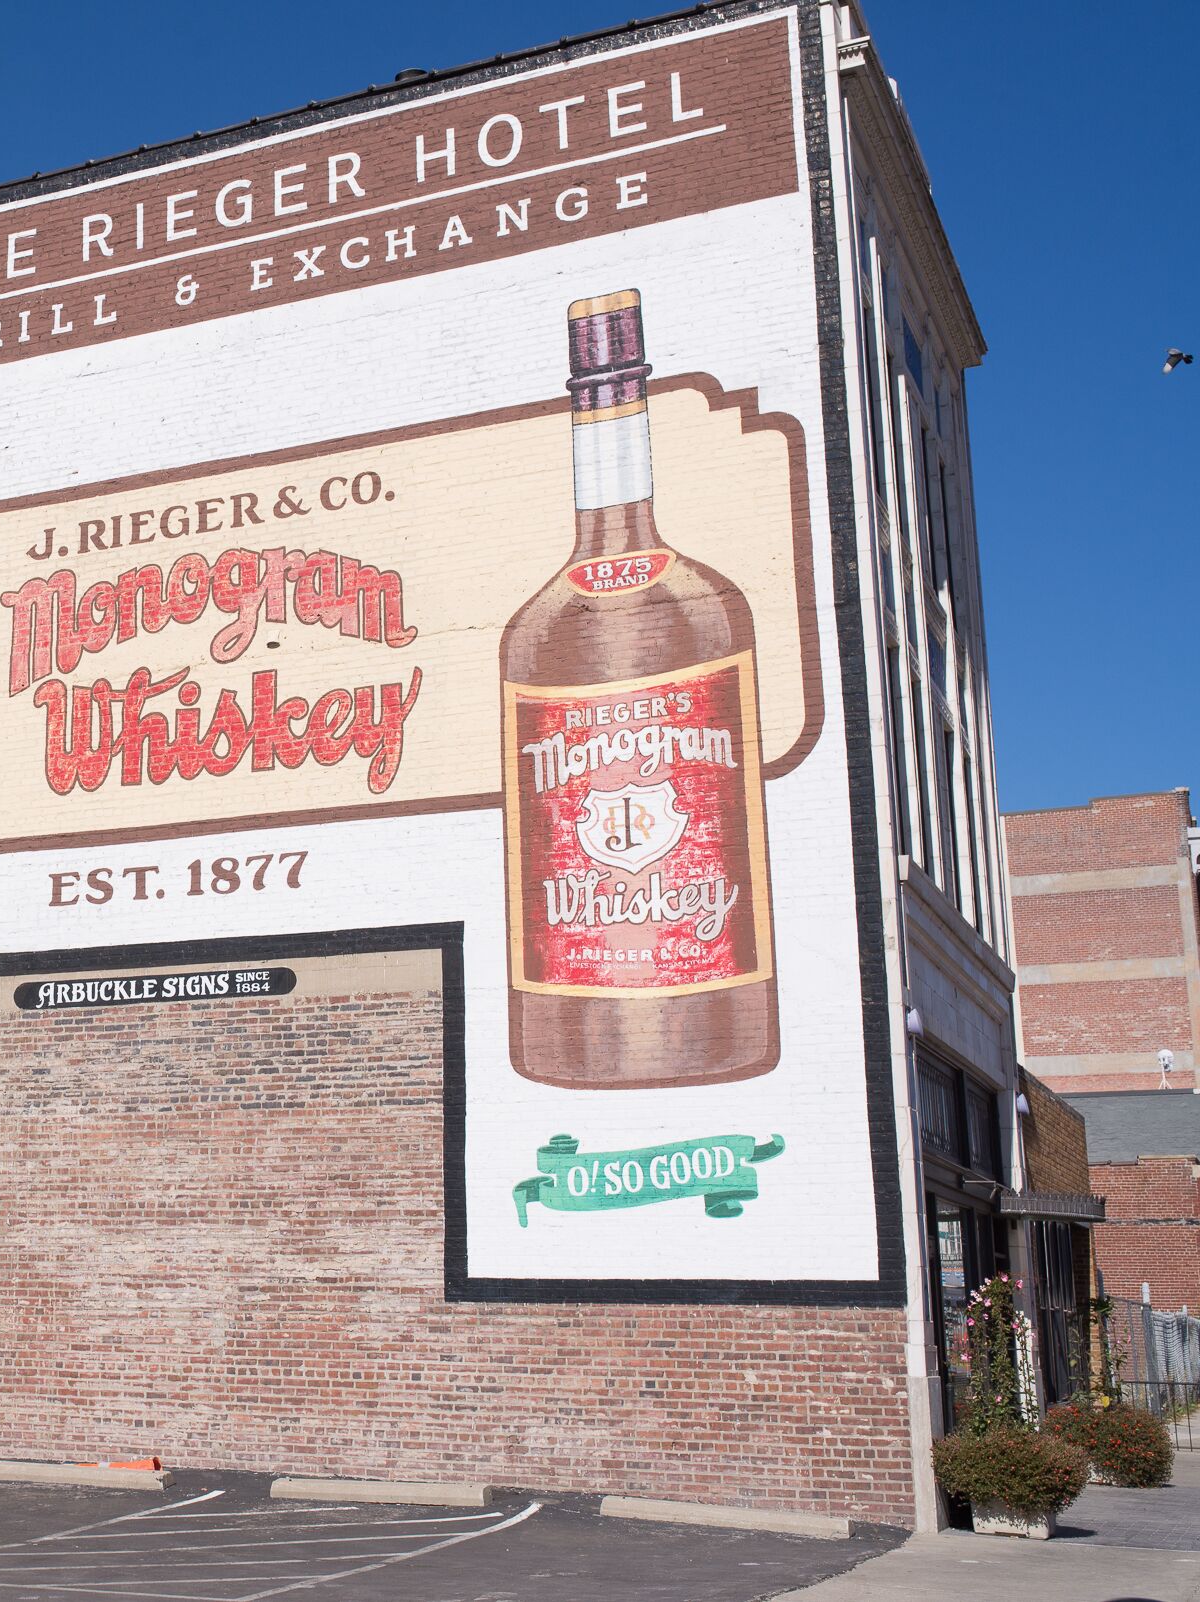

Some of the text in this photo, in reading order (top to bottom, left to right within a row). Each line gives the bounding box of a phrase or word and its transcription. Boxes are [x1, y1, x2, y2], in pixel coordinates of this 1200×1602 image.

[81, 151, 366, 262] RIEGER
[415, 71, 704, 184] HOTEL
[175, 274, 200, 306] &
[249, 171, 649, 292] EXCHANGE
[25, 470, 396, 561] J. RIEGER & CO.
[583, 557, 652, 581] 1875
[591, 573, 649, 591] BRAND
[0, 546, 418, 697] Monogram
[32, 666, 423, 796] Whiskey
[565, 692, 693, 730] RIEGER'S
[521, 724, 739, 794] Monogram
[48, 851, 309, 907] EST. 1877
[543, 869, 739, 941] Whiskey
[36, 973, 230, 1009] ARBUCKLE SIGNS
[235, 971, 271, 983] SINCE
[235, 981, 271, 994] 1884
[567, 1145, 735, 1197] O! SO GOOD
